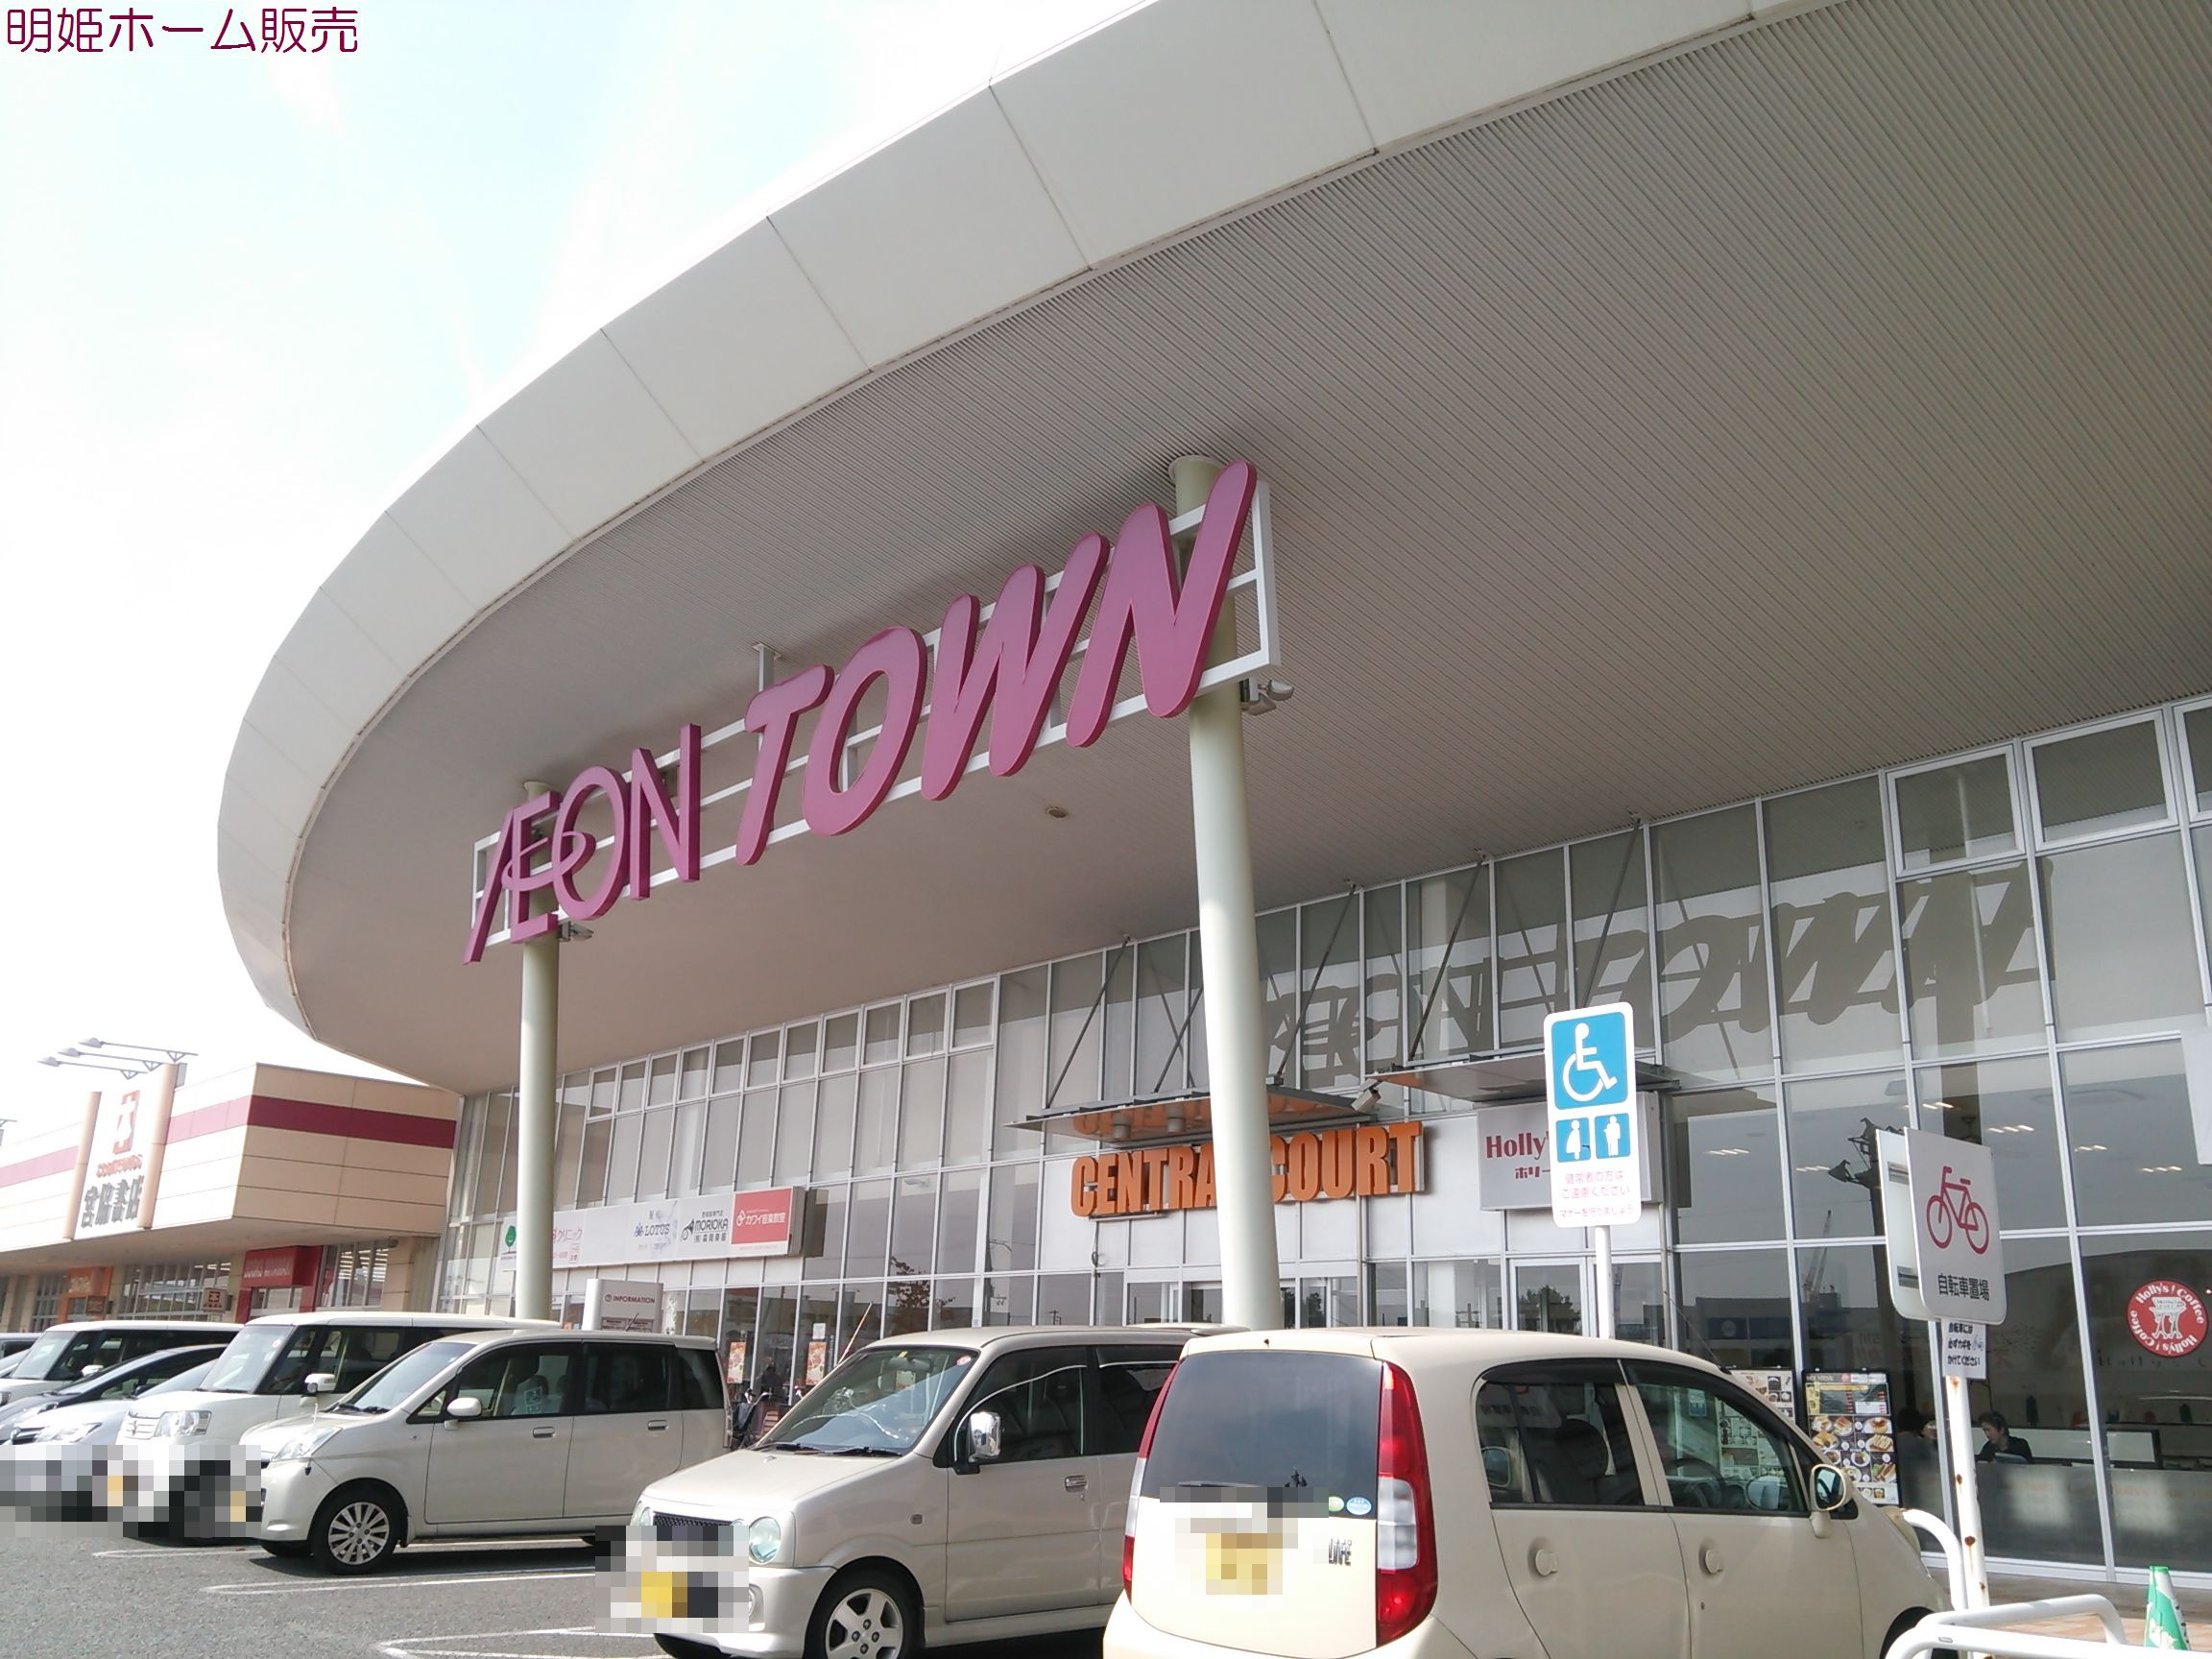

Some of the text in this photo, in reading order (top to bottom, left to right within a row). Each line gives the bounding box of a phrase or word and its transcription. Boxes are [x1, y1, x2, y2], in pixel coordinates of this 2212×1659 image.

[735, 460, 1258, 867] TOWN
[1070, 1120, 1424, 1217] CENTRA COURT
[644, 1223, 671, 1237] LOTUS
[694, 1218, 729, 1232] MORIOKA
[1937, 1273, 1990, 1302] 自転車置場
[613, 1295, 656, 1304] INFORMATION
[2176, 1288, 2204, 1324] Coffee
[1948, 1322, 1974, 1334] 自転車には
[2130, 1310, 2155, 1346] Coffee
[1947, 1355, 1981, 1367] かけてください
